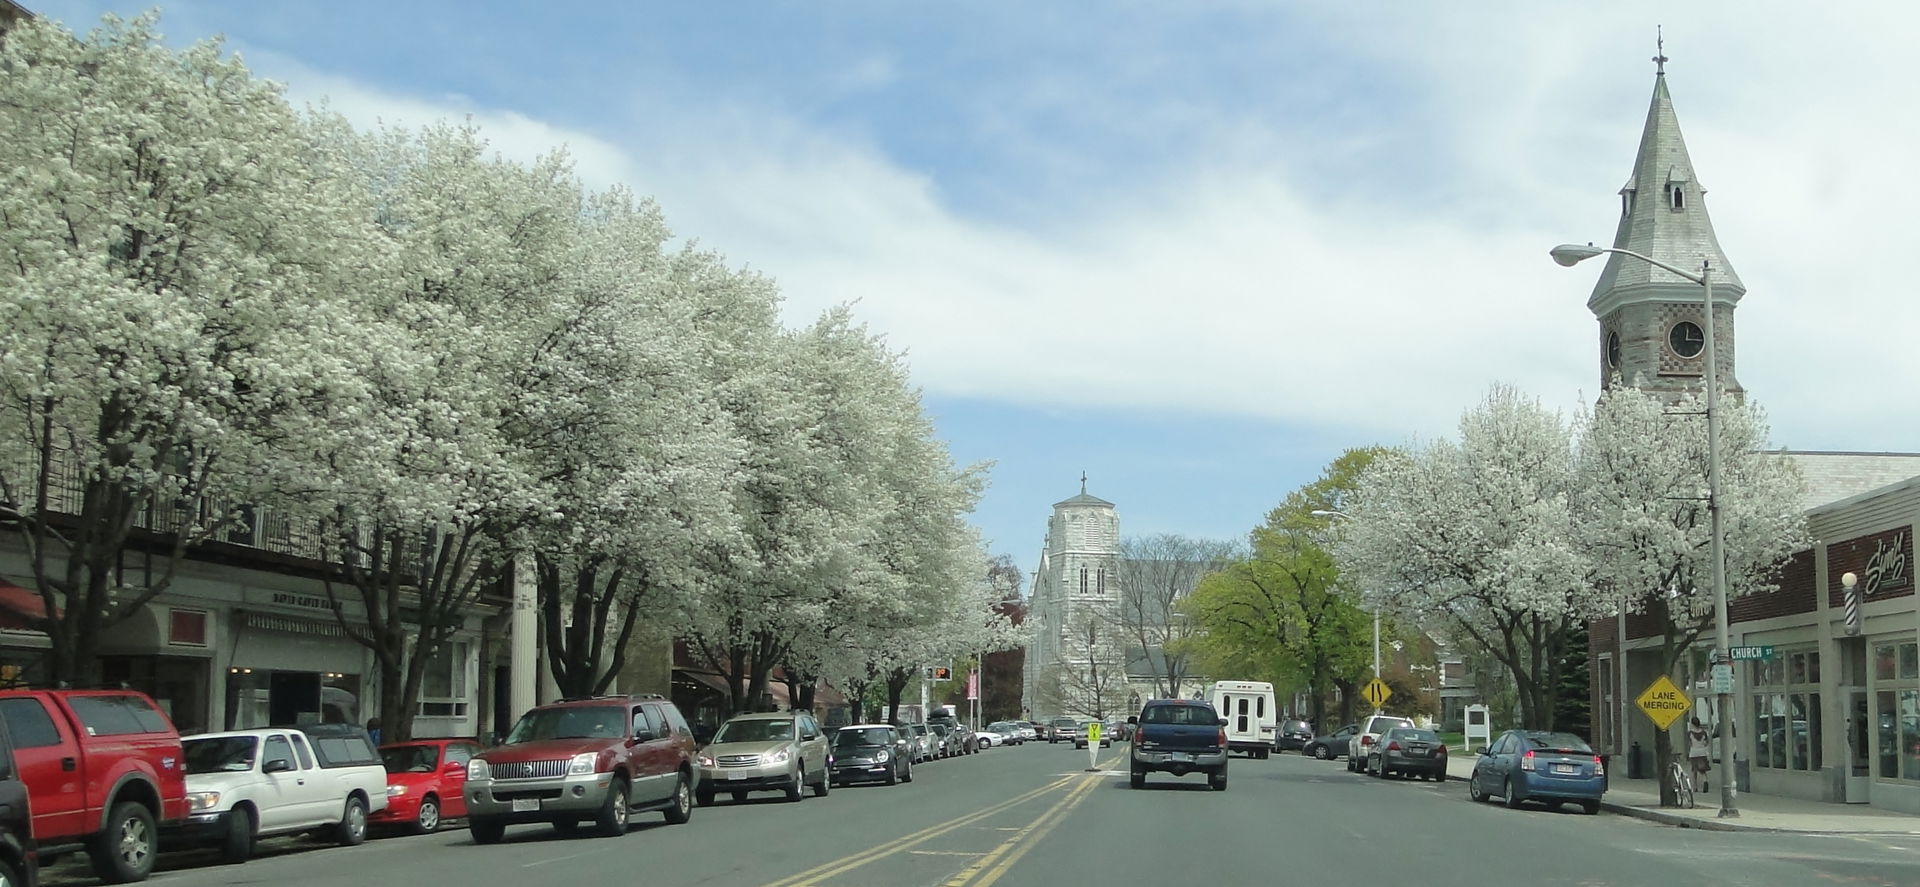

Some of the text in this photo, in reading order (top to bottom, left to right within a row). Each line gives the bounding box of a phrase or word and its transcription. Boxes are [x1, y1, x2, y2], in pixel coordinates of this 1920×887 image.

[1730, 647, 1773, 659] CHURCH ST
[1652, 691, 1676, 700] LANE
[1643, 701, 1685, 710] MERGING
